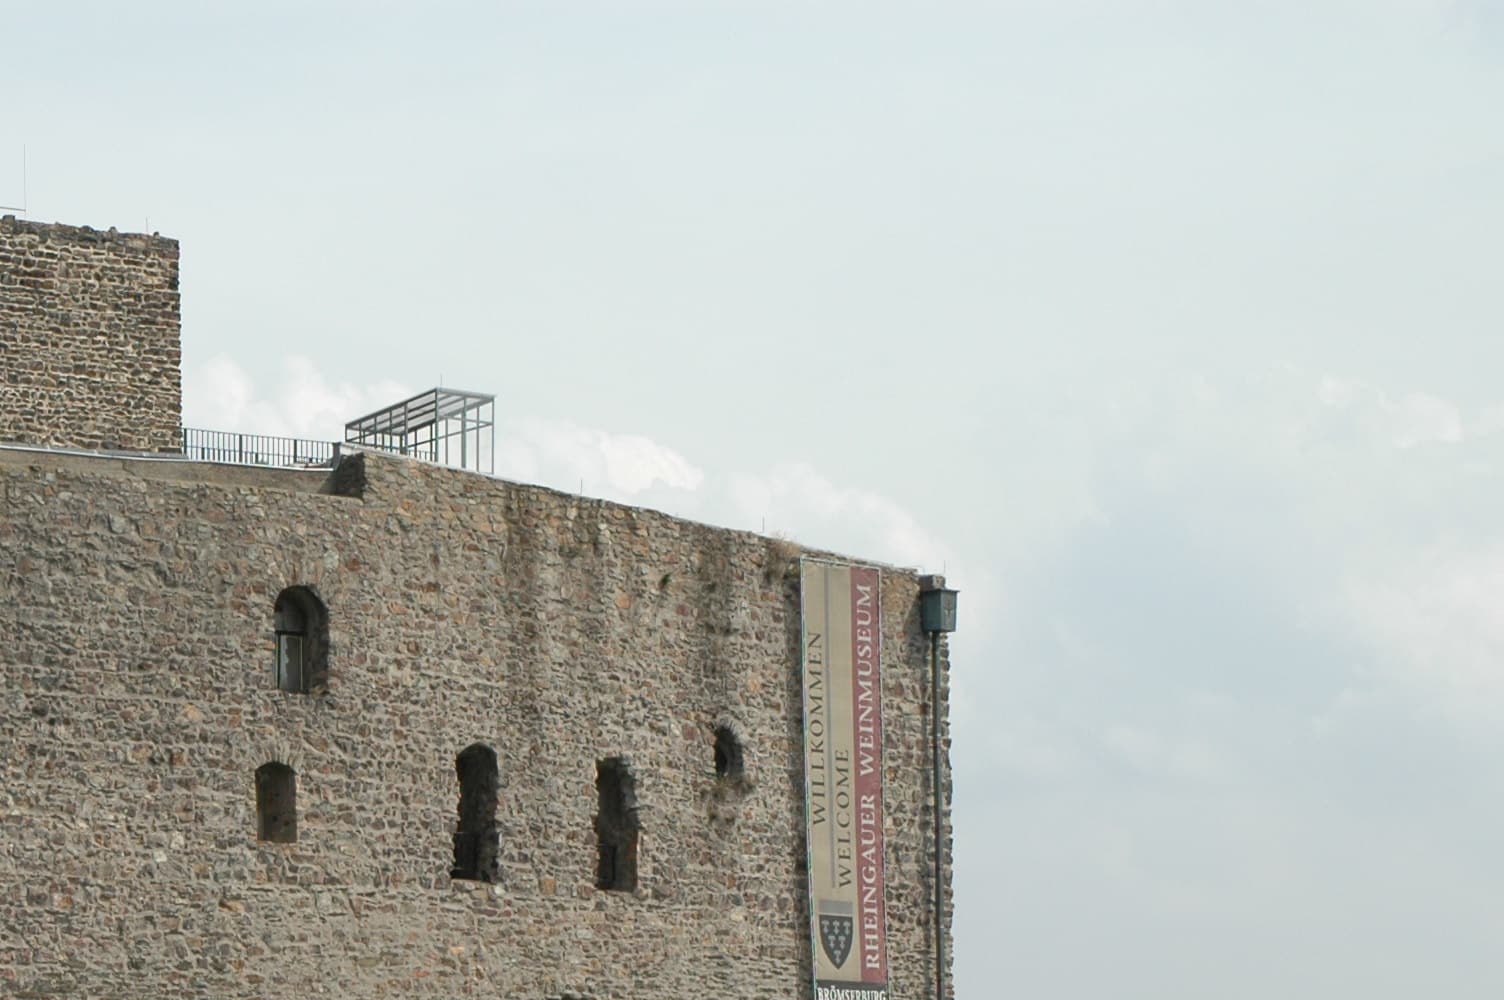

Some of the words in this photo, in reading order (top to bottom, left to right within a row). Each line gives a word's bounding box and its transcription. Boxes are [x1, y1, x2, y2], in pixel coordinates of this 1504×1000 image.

[808, 632, 827, 825] WILLKOMMEN
[857, 584, 875, 776] WEINMUSEUM
[835, 750, 852, 888] WELCOME
[861, 795, 880, 969] RHEINGAUER
